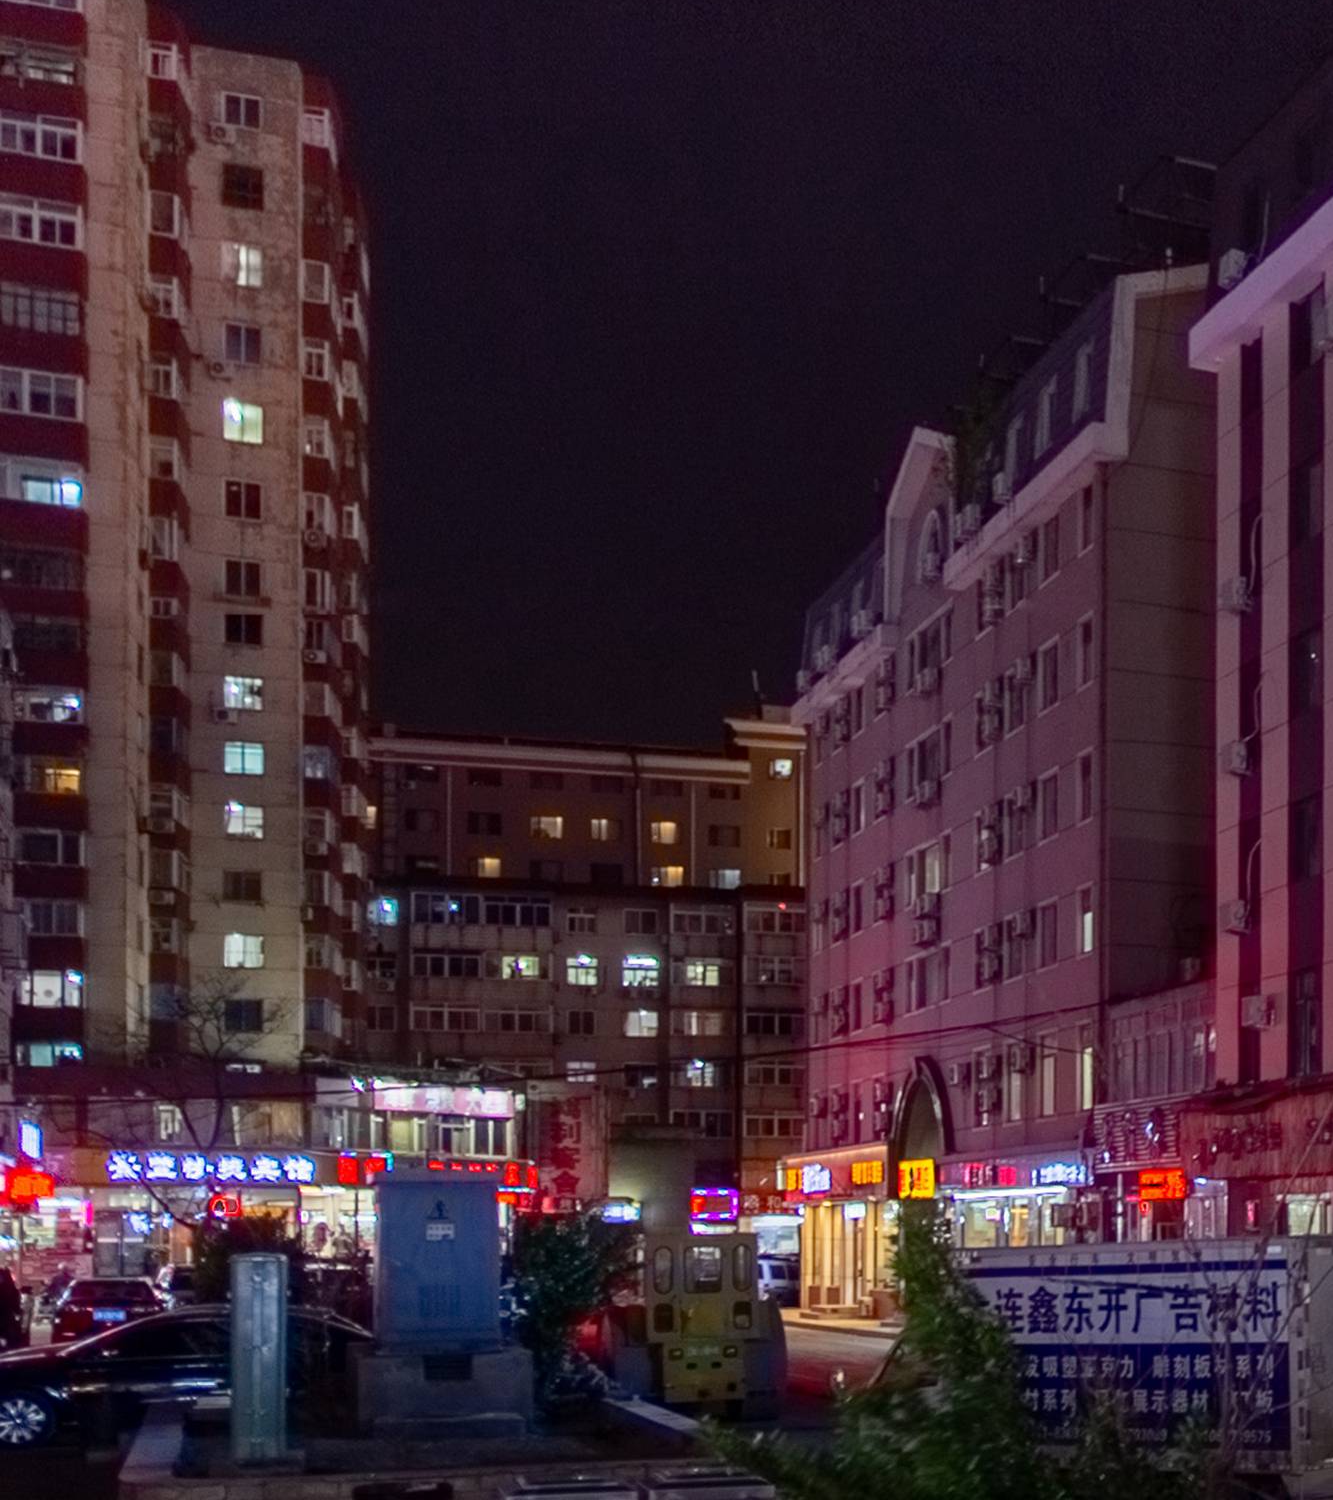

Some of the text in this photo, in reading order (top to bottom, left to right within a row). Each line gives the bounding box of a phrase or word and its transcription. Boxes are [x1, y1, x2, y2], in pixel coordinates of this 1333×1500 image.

[984, 1281, 1282, 1334] 连鑫东开广告材料
